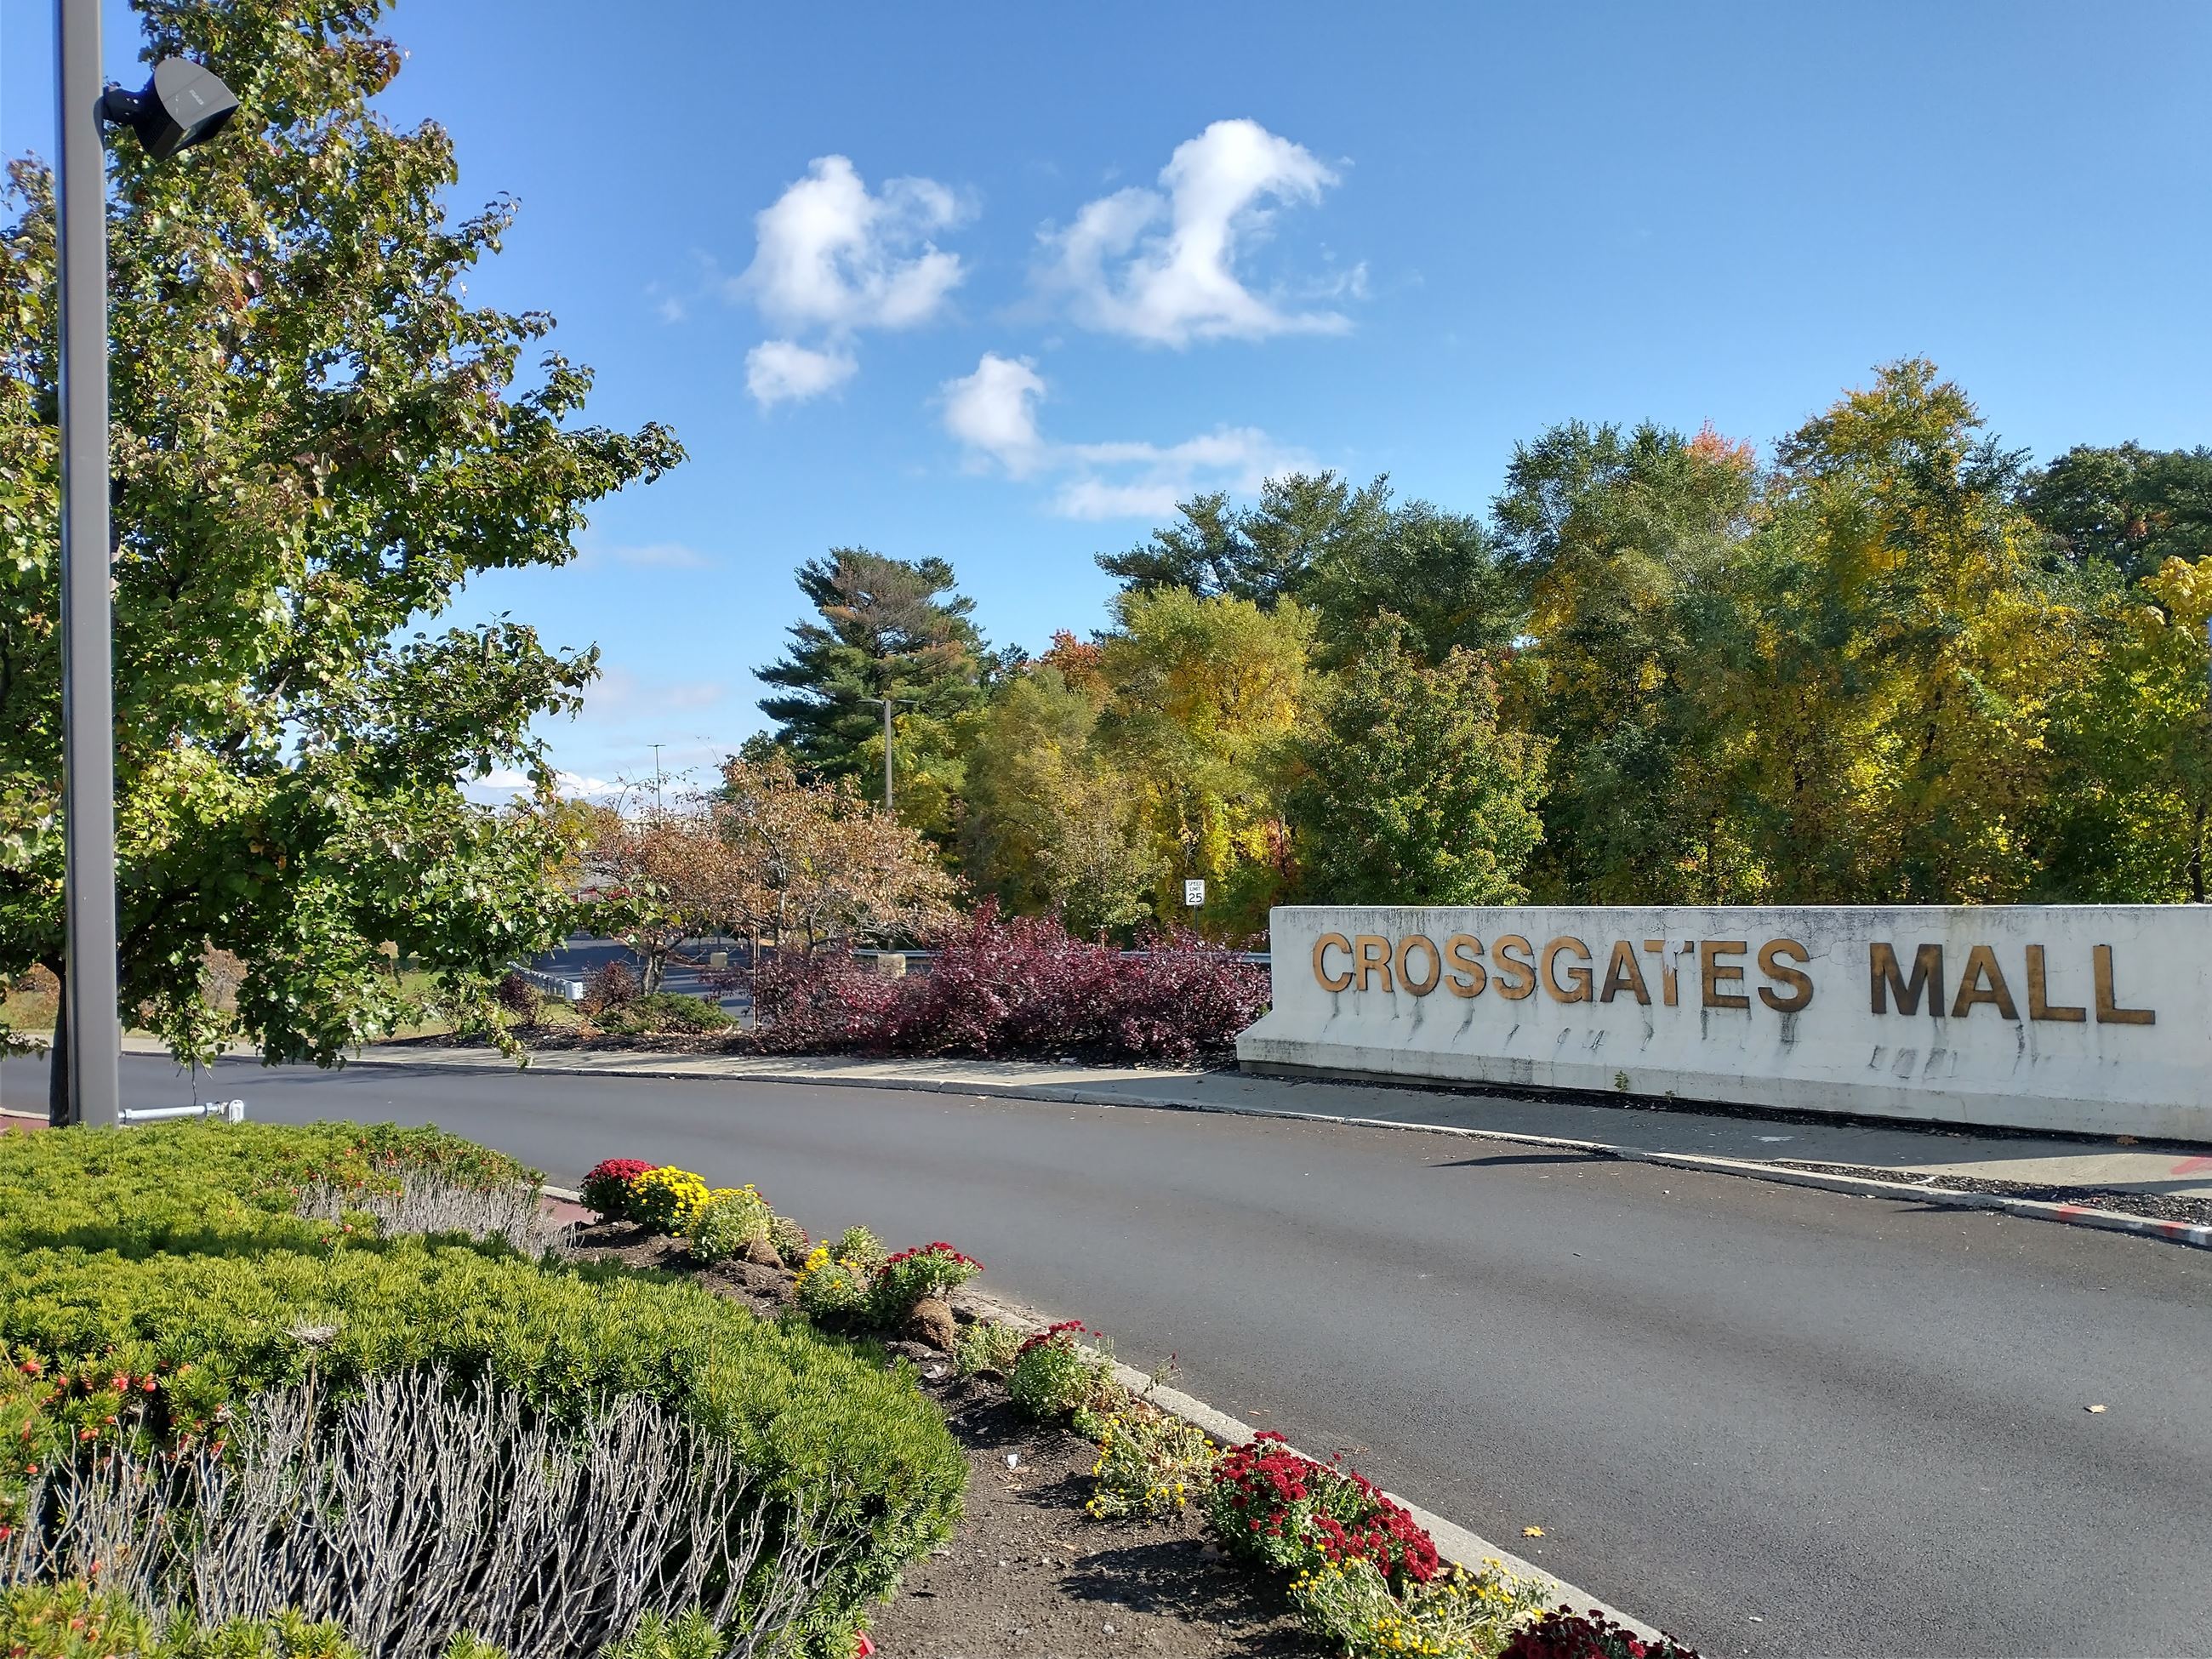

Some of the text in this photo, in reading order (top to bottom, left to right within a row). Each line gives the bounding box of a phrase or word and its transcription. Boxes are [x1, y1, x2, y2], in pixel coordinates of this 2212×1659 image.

[1189, 893, 1202, 902] 25
[1313, 932, 2156, 1024] CROSSGATES MALL
